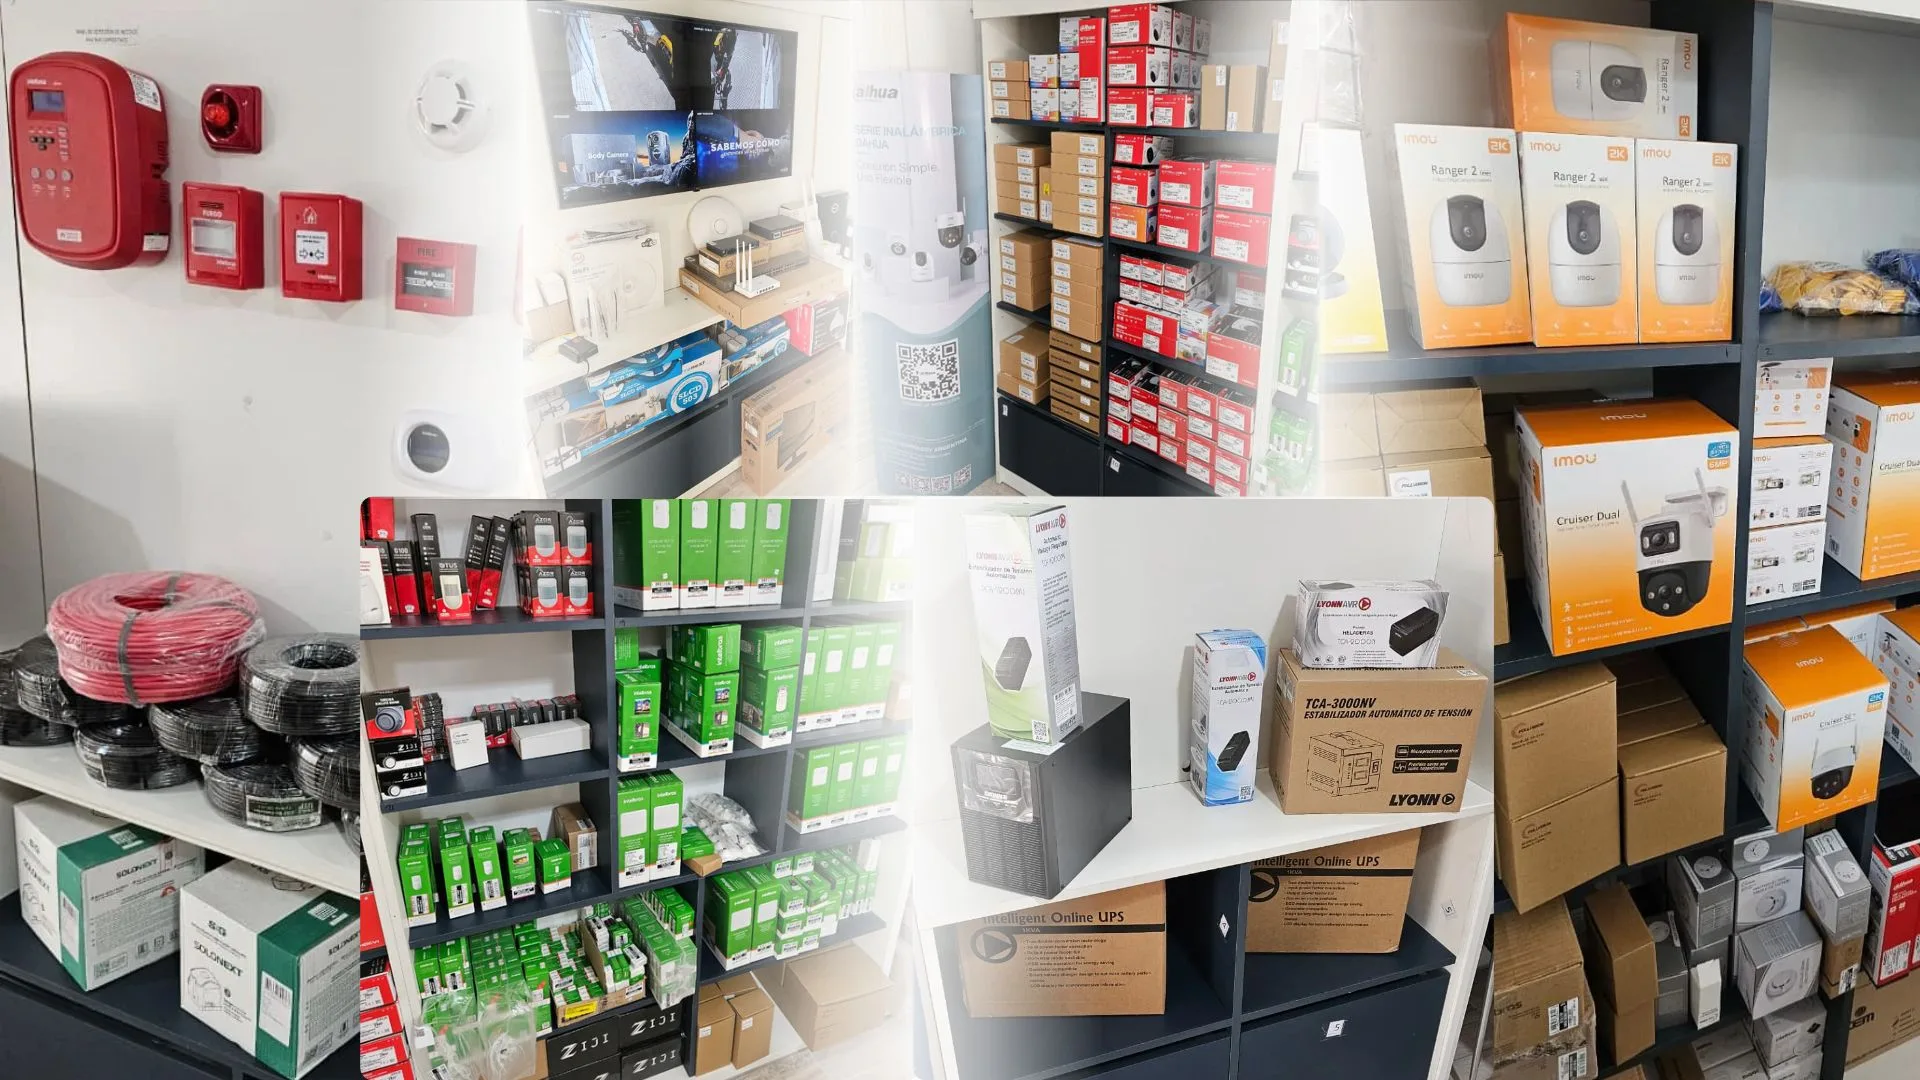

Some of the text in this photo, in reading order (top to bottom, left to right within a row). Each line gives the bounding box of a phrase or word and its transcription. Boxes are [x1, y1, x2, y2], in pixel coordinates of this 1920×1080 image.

[1660, 58, 1671, 94] Ranger
[711, 142, 754, 152] SABEMOS
[587, 152, 605, 160] Body
[1431, 164, 1478, 177] Ranger 2
[1553, 171, 1597, 184] Ranger 2
[1662, 176, 1702, 189] Ranger 2
[1553, 453, 1596, 467] imou
[1556, 509, 1620, 526] Cruiser Dual
[1305, 697, 1376, 709] TCA-3000NV
[1304, 707, 1473, 719] ESTABILIZADOR AUTOMÁTICO DE TENSIÓN
[1389, 793, 1440, 806] LYONN
[1314, 855, 1352, 867] Online
[1356, 855, 1381, 867] UPS
[1050, 911, 1094, 923] Online
[1098, 911, 1125, 923] UPS
[194, 940, 244, 977] SOLONEXT
